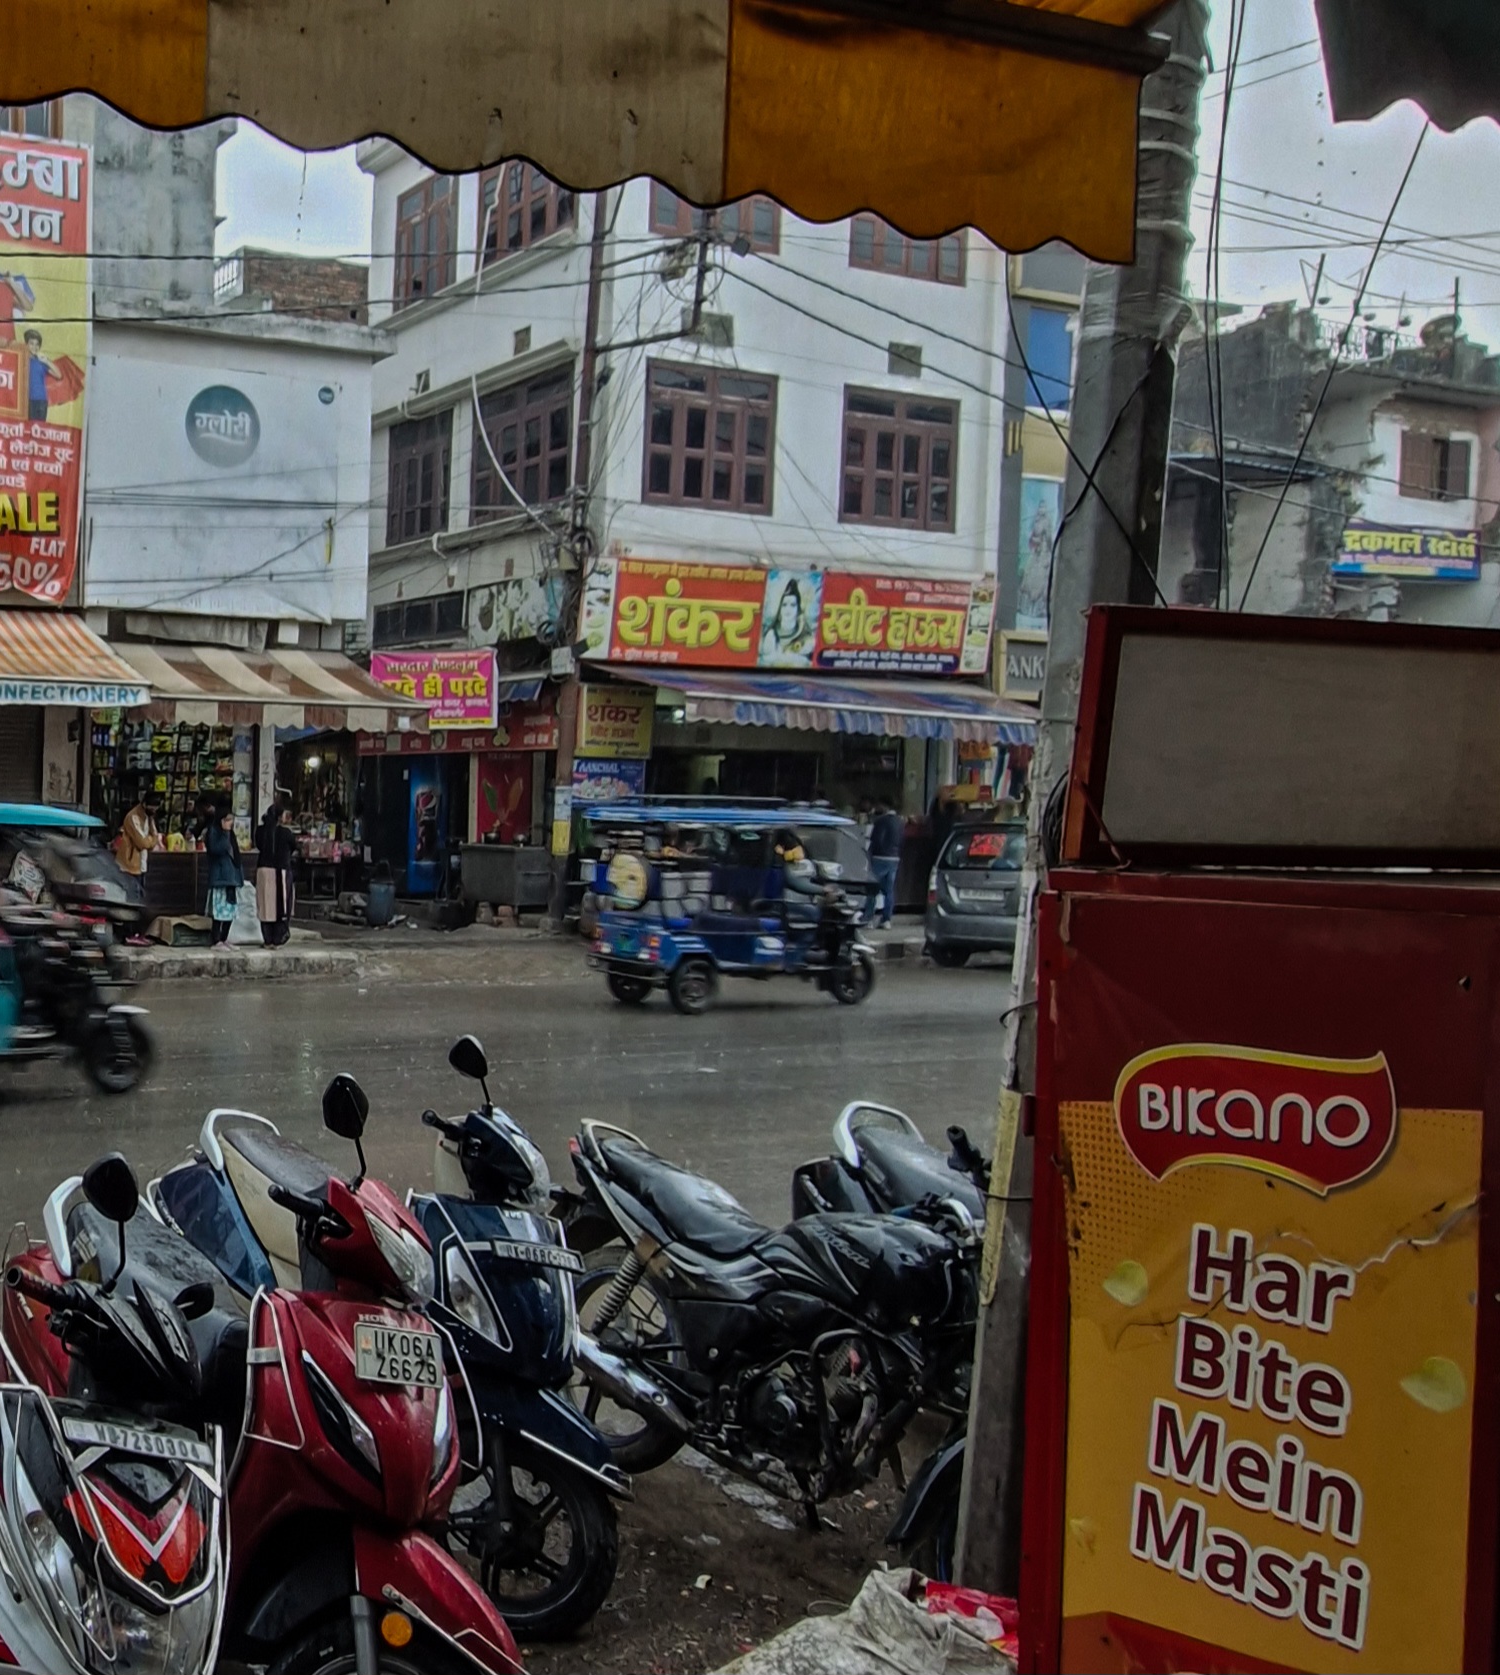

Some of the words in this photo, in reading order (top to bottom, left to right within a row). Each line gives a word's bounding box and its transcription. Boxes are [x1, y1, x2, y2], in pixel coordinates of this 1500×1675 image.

[194, 409, 251, 437] ग्लोरी
[30, 537, 67, 557] FLAT
[617, 578, 761, 651] शंकर
[822, 587, 887, 646] स्वीट
[887, 607, 966, 651] हाऊस
[423, 673, 443, 698] ही
[449, 671, 489, 697] परदे
[587, 698, 645, 724] शंकर
[1192, 1225, 1352, 1331] Har
[374, 1330, 435, 1360] UK06A
[1177, 1315, 1350, 1435] Bite
[1150, 1400, 1361, 1544] Mein
[1132, 1485, 1368, 1649] Masti
